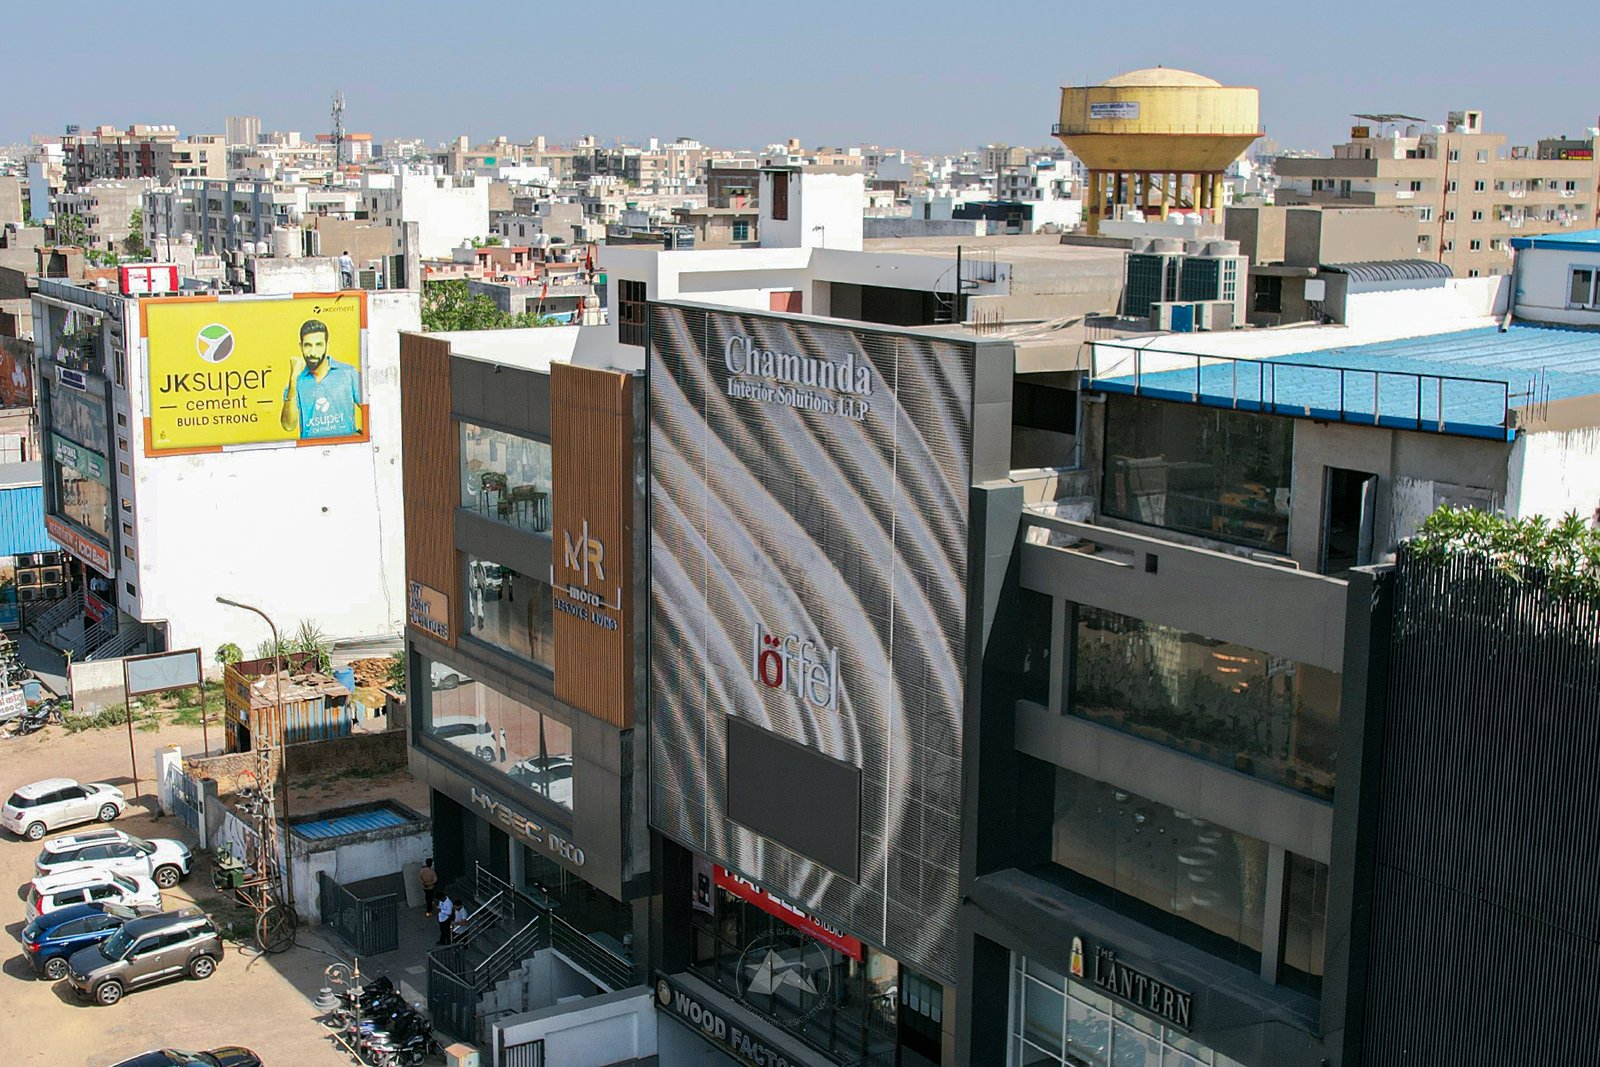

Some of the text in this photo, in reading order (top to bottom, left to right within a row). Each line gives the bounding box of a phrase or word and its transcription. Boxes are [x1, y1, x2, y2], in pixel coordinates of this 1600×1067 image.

[724, 334, 872, 397] Chamunda
[186, 394, 247, 411] cement
[727, 377, 869, 421] Interior Solutions LLP
[177, 413, 258, 427] BUILD STRONG
[591, 610, 618, 631] LIVING
[753, 622, 838, 711] löffel
[549, 833, 586, 866] DECO
[1096, 945, 1114, 961] THE
[1094, 956, 1191, 1028] LANTERN
[674, 990, 727, 1041] WOOD
